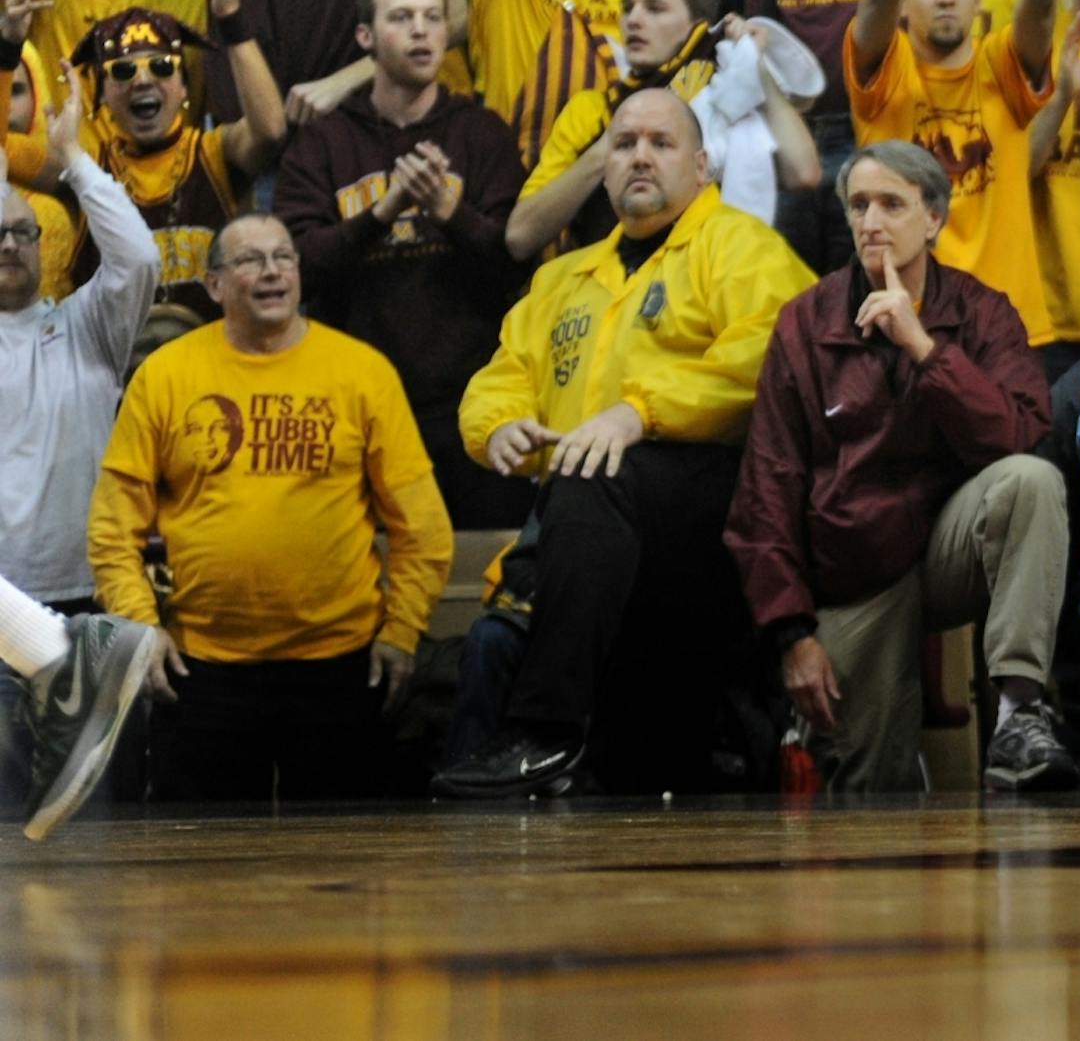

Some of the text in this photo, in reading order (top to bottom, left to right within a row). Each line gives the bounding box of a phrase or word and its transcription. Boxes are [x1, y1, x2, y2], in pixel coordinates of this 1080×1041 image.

[250, 393, 294, 417] IT'S
[249, 416, 336, 443] TUBBY
[246, 442, 336, 477] TIME!
